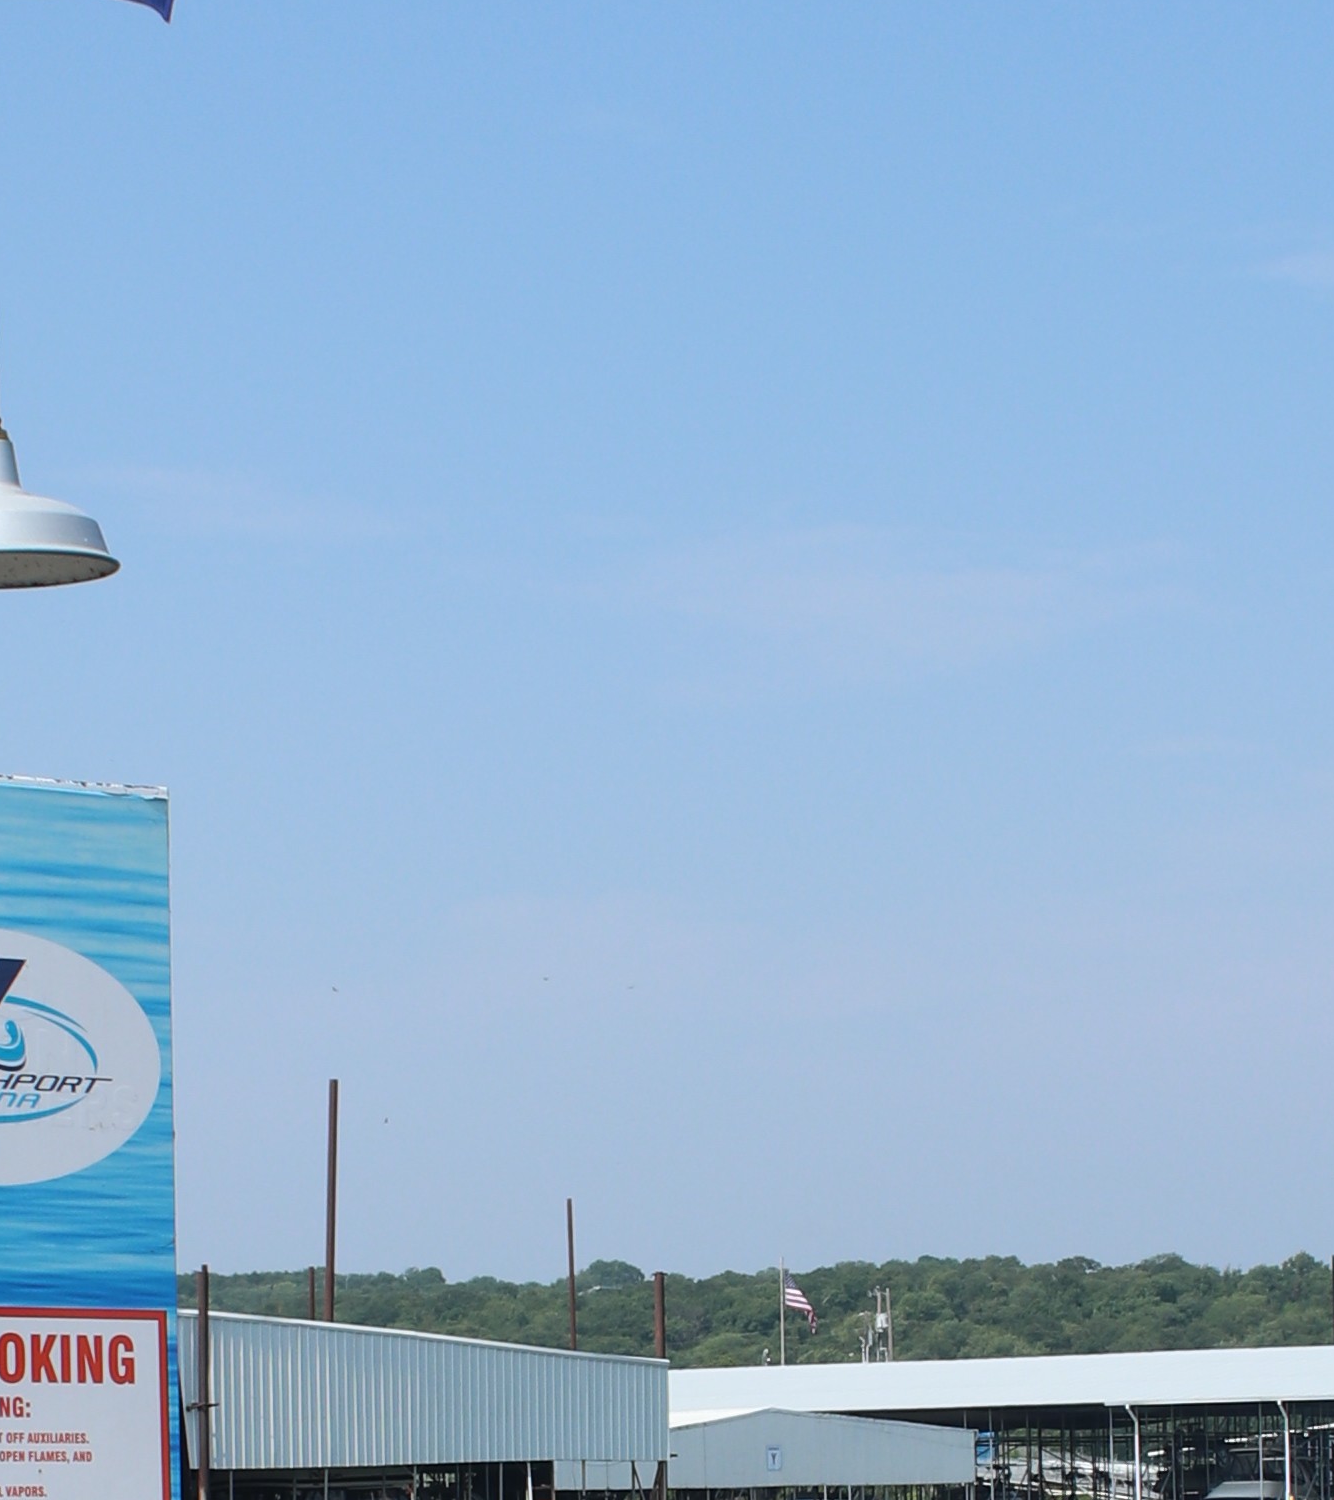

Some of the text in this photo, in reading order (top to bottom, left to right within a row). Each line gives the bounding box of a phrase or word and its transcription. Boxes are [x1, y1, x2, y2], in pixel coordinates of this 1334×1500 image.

[5, 1432, 25, 1443] OFF
[27, 1432, 89, 1444] AUXILIARIES.
[0, 1450, 25, 1462] OPEN
[28, 1450, 70, 1463] FLAMES,
[72, 1451, 92, 1462] AND
[5, 1485, 47, 1497] VAPORS.
